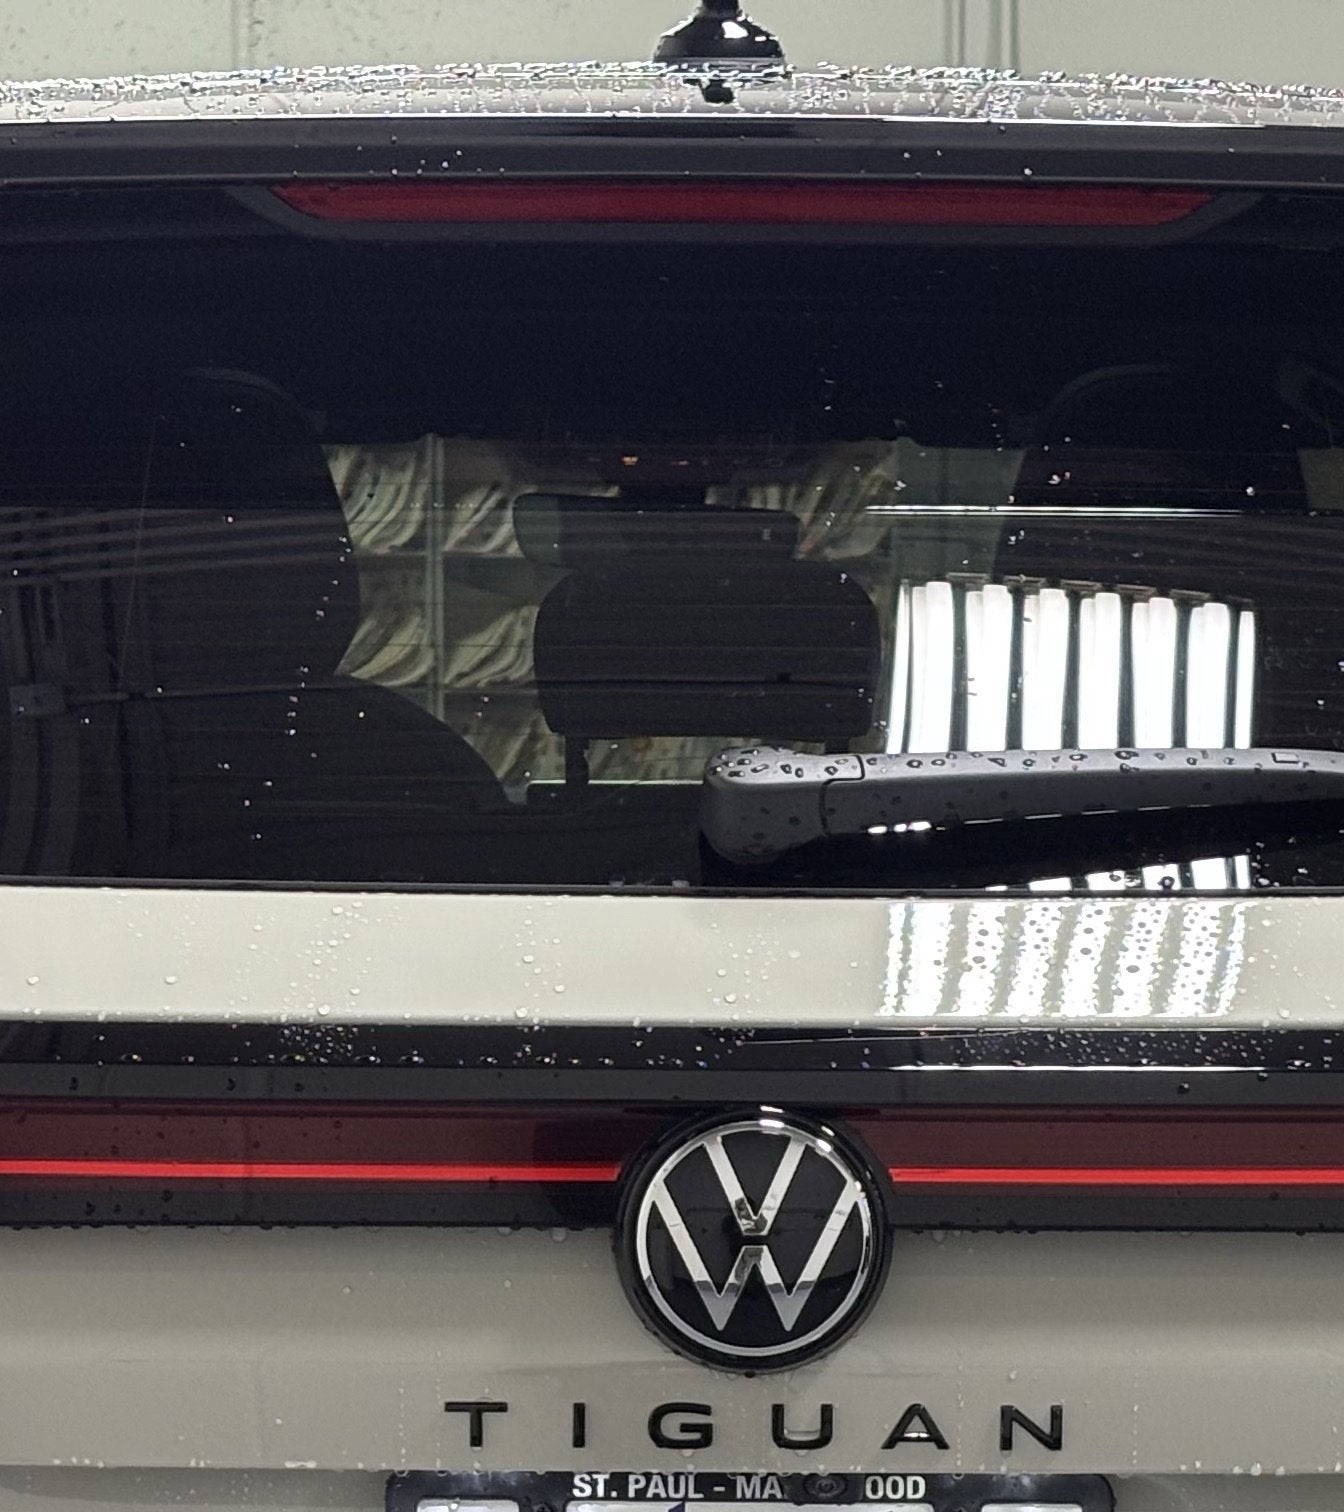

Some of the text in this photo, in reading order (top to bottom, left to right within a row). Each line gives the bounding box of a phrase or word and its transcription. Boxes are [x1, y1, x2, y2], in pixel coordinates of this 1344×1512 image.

[445, 1402, 1064, 1450] TIGUAN
[572, 1475, 617, 1499] ST.
[627, 1474, 703, 1499] PAUL
[736, 1475, 926, 1499] MAOOD
